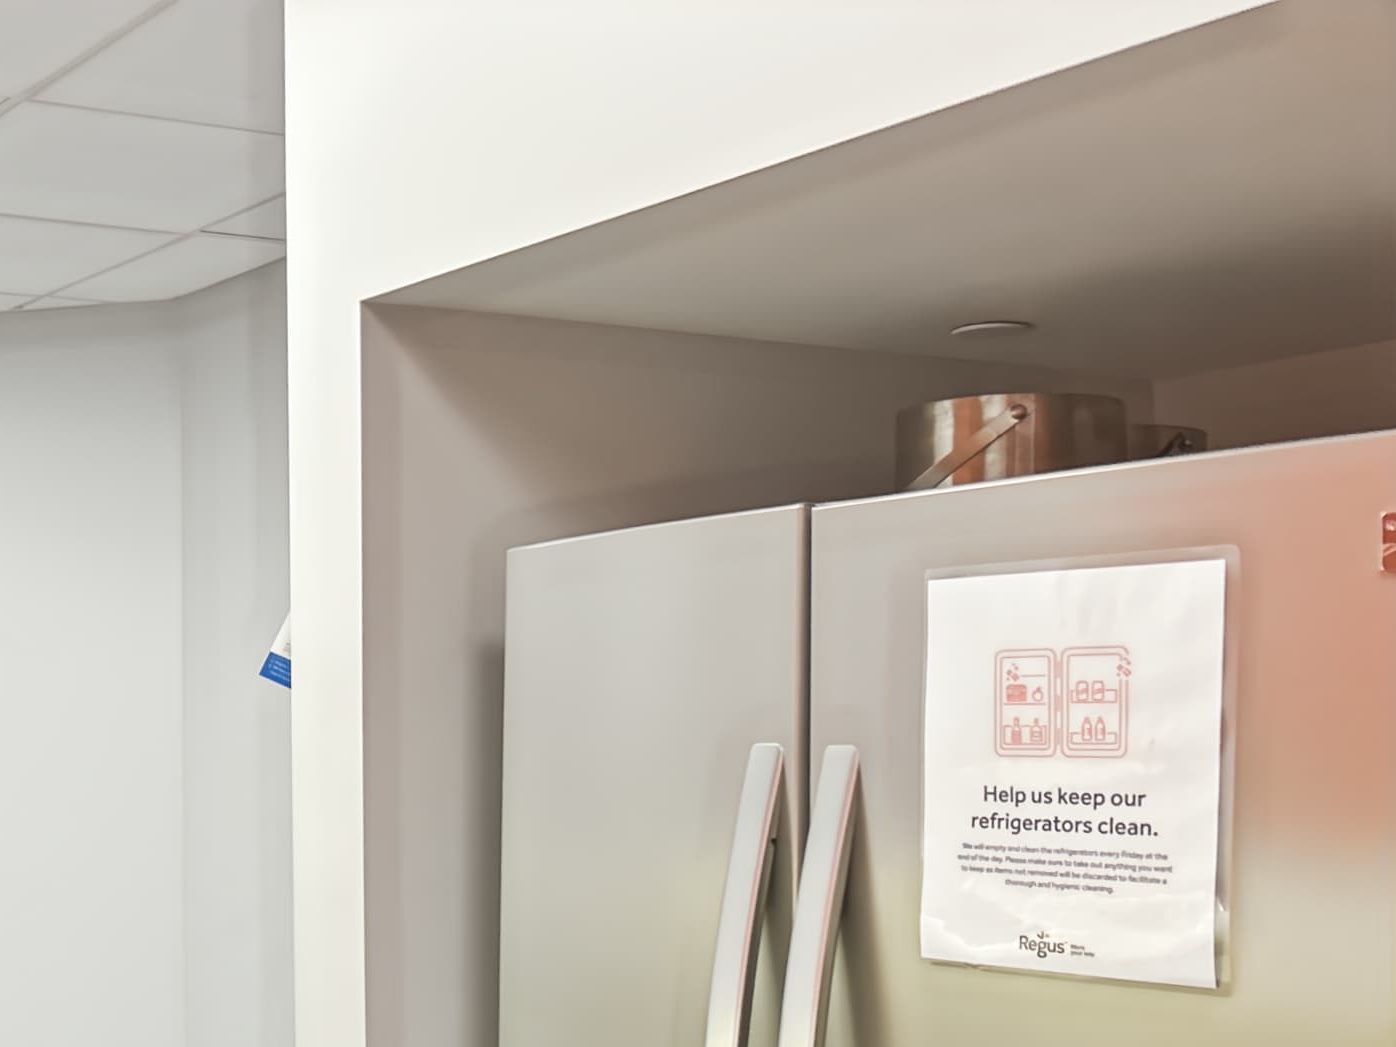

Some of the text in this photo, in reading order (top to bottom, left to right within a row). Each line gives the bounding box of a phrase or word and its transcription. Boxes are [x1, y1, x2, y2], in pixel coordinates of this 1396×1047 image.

[983, 785, 1147, 810] Help us keep our
[970, 812, 1159, 837] refrigerators clean.
[1018, 932, 1066, 959] Regus
